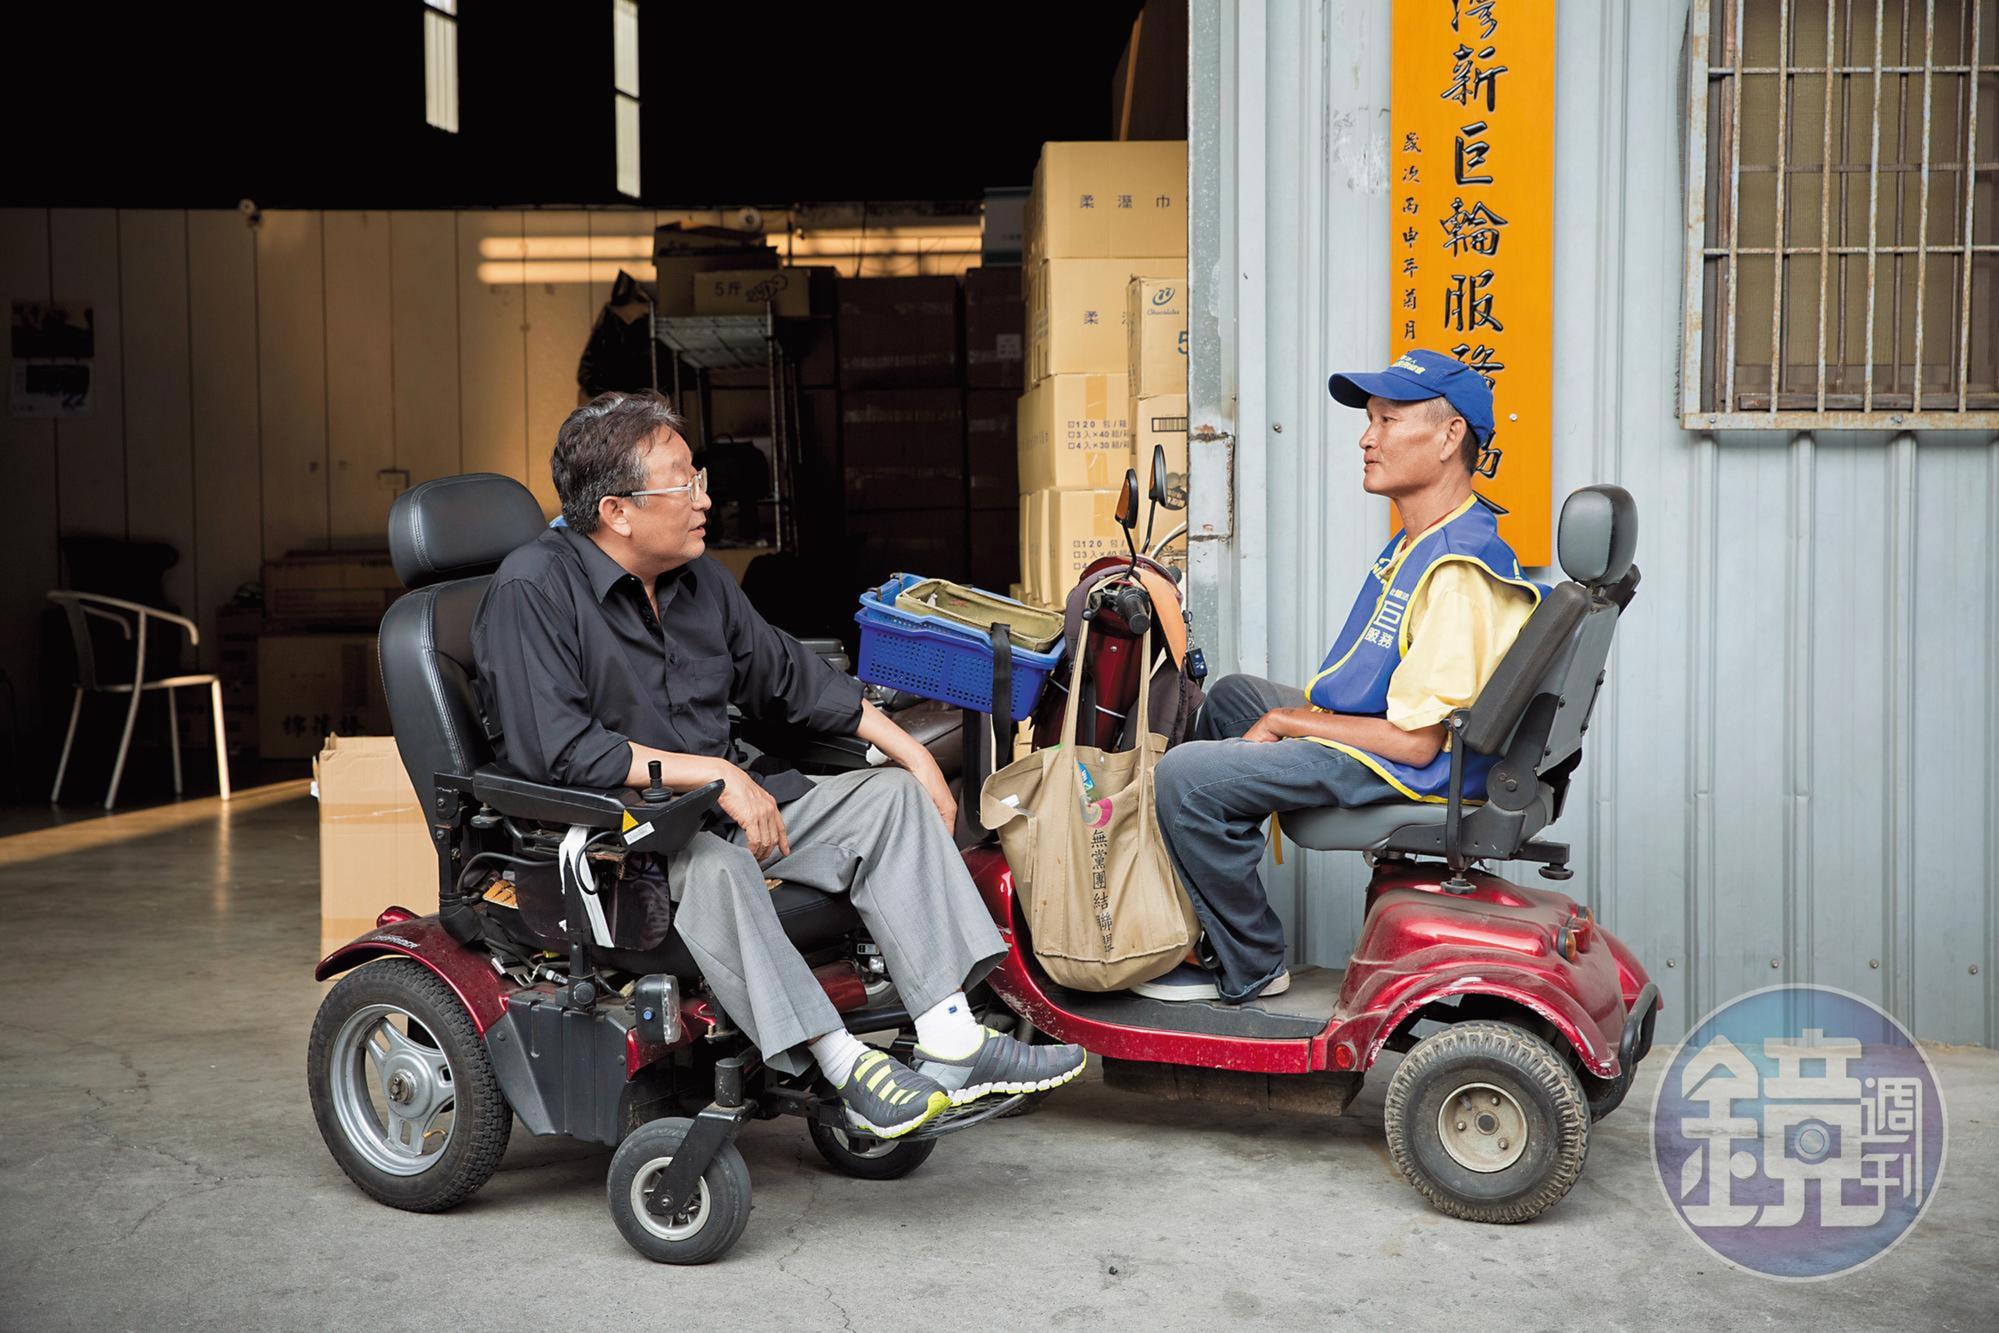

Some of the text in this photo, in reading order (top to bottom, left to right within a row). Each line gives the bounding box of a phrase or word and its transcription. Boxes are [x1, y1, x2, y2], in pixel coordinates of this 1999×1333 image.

[1364, 627, 1394, 649] 服務
[1090, 829, 1115, 953] 無黨團結聯盟
